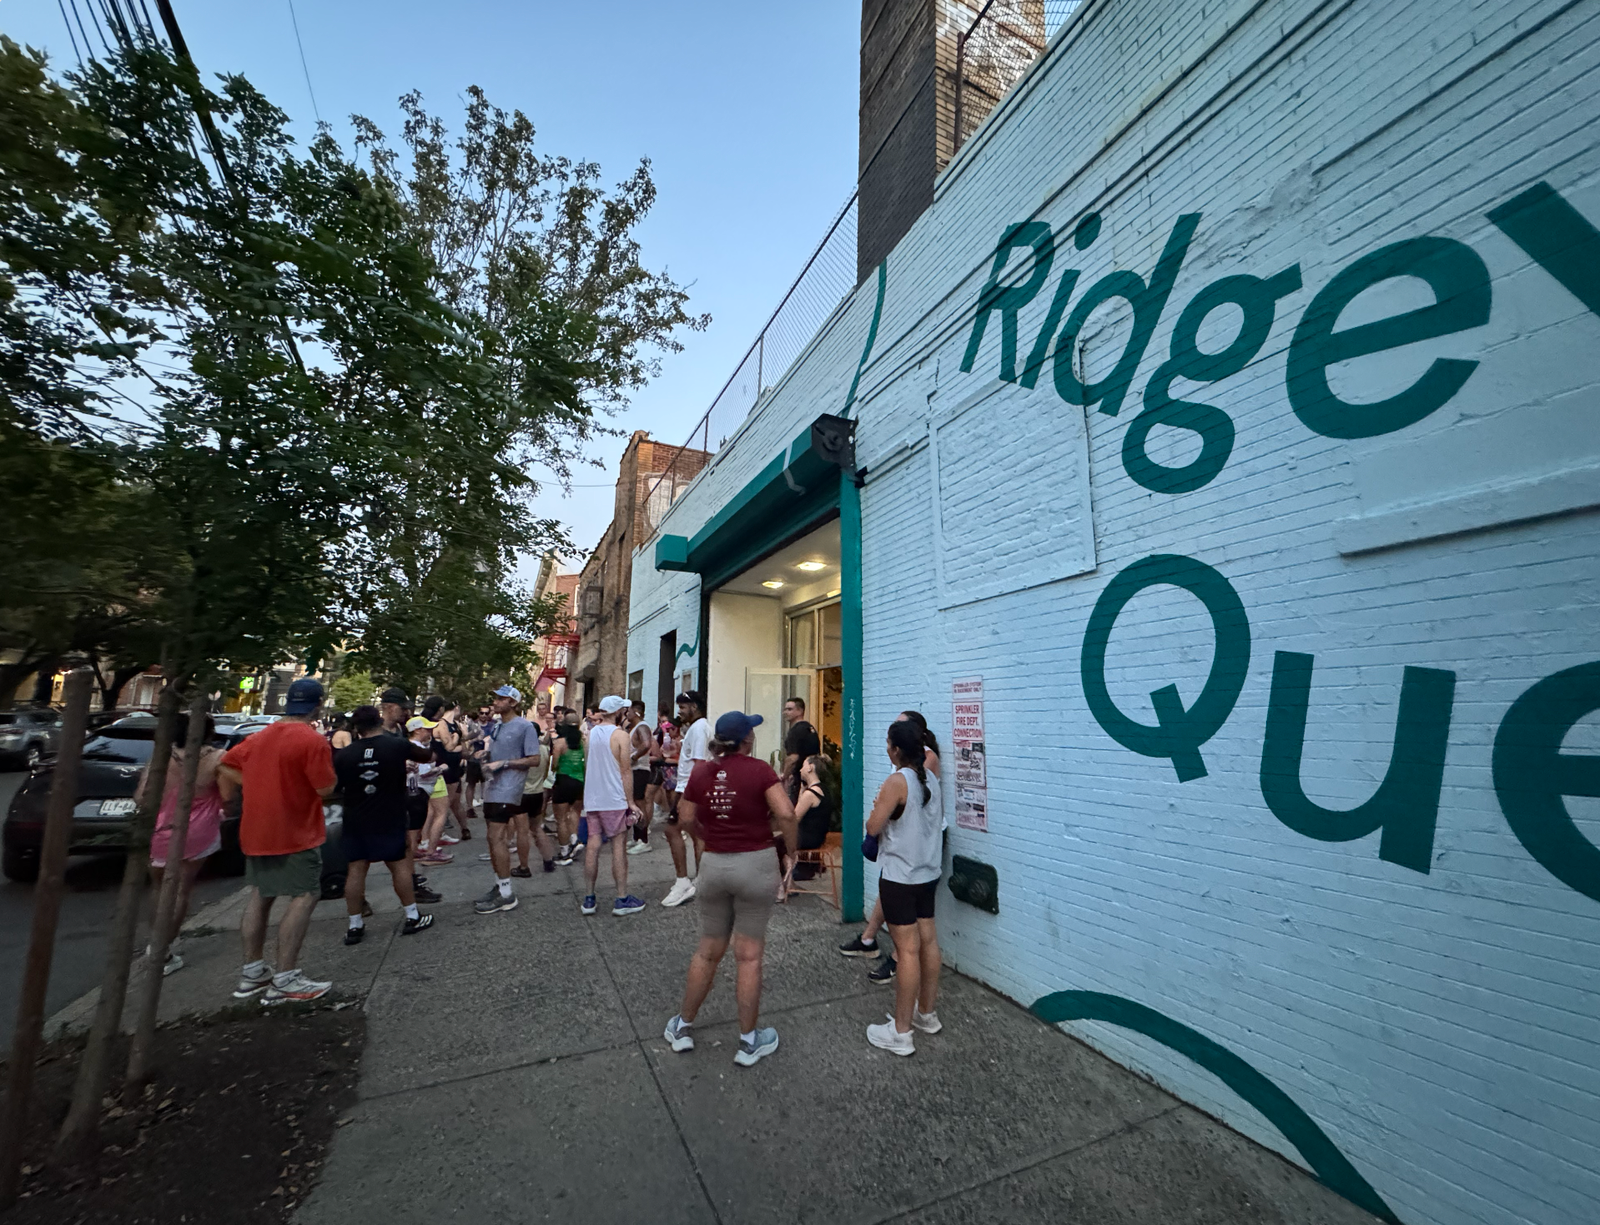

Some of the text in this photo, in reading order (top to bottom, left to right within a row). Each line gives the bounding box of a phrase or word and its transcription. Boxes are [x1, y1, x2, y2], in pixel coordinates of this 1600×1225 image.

[955, 704, 979, 714] SPRINKLER
[956, 716, 979, 726] FIRE DEPT.
[953, 728, 982, 738] CONNECTION
